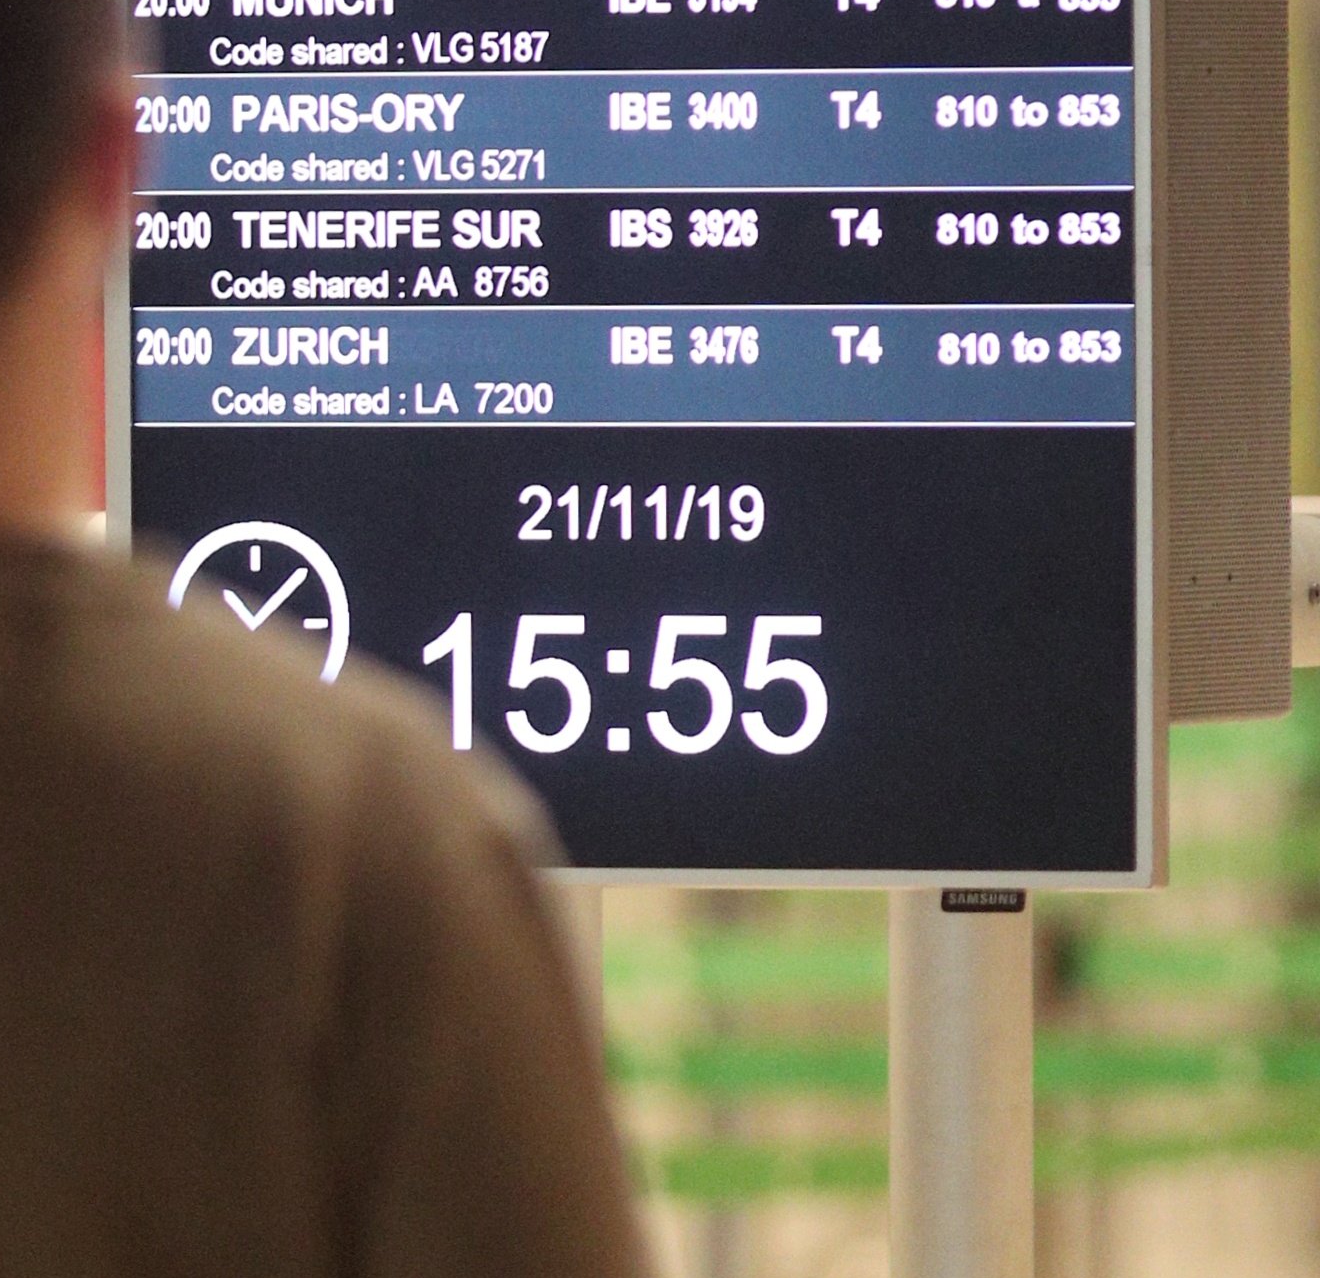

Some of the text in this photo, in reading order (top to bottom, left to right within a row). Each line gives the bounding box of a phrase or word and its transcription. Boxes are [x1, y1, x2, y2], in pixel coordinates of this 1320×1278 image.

[133, 90, 759, 135] 20:00 PARIS-ORY IBE 3400
[134, 207, 760, 250] 20:00 TENERIFE SUR IBS 3926
[135, 324, 1123, 368] 20:00 ZURICH IBE 3476 T4 810 to 853
[517, 483, 766, 543] 21/11/19
[422, 611, 829, 756] 15:55
[948, 891, 1018, 905] SAMSUNG
